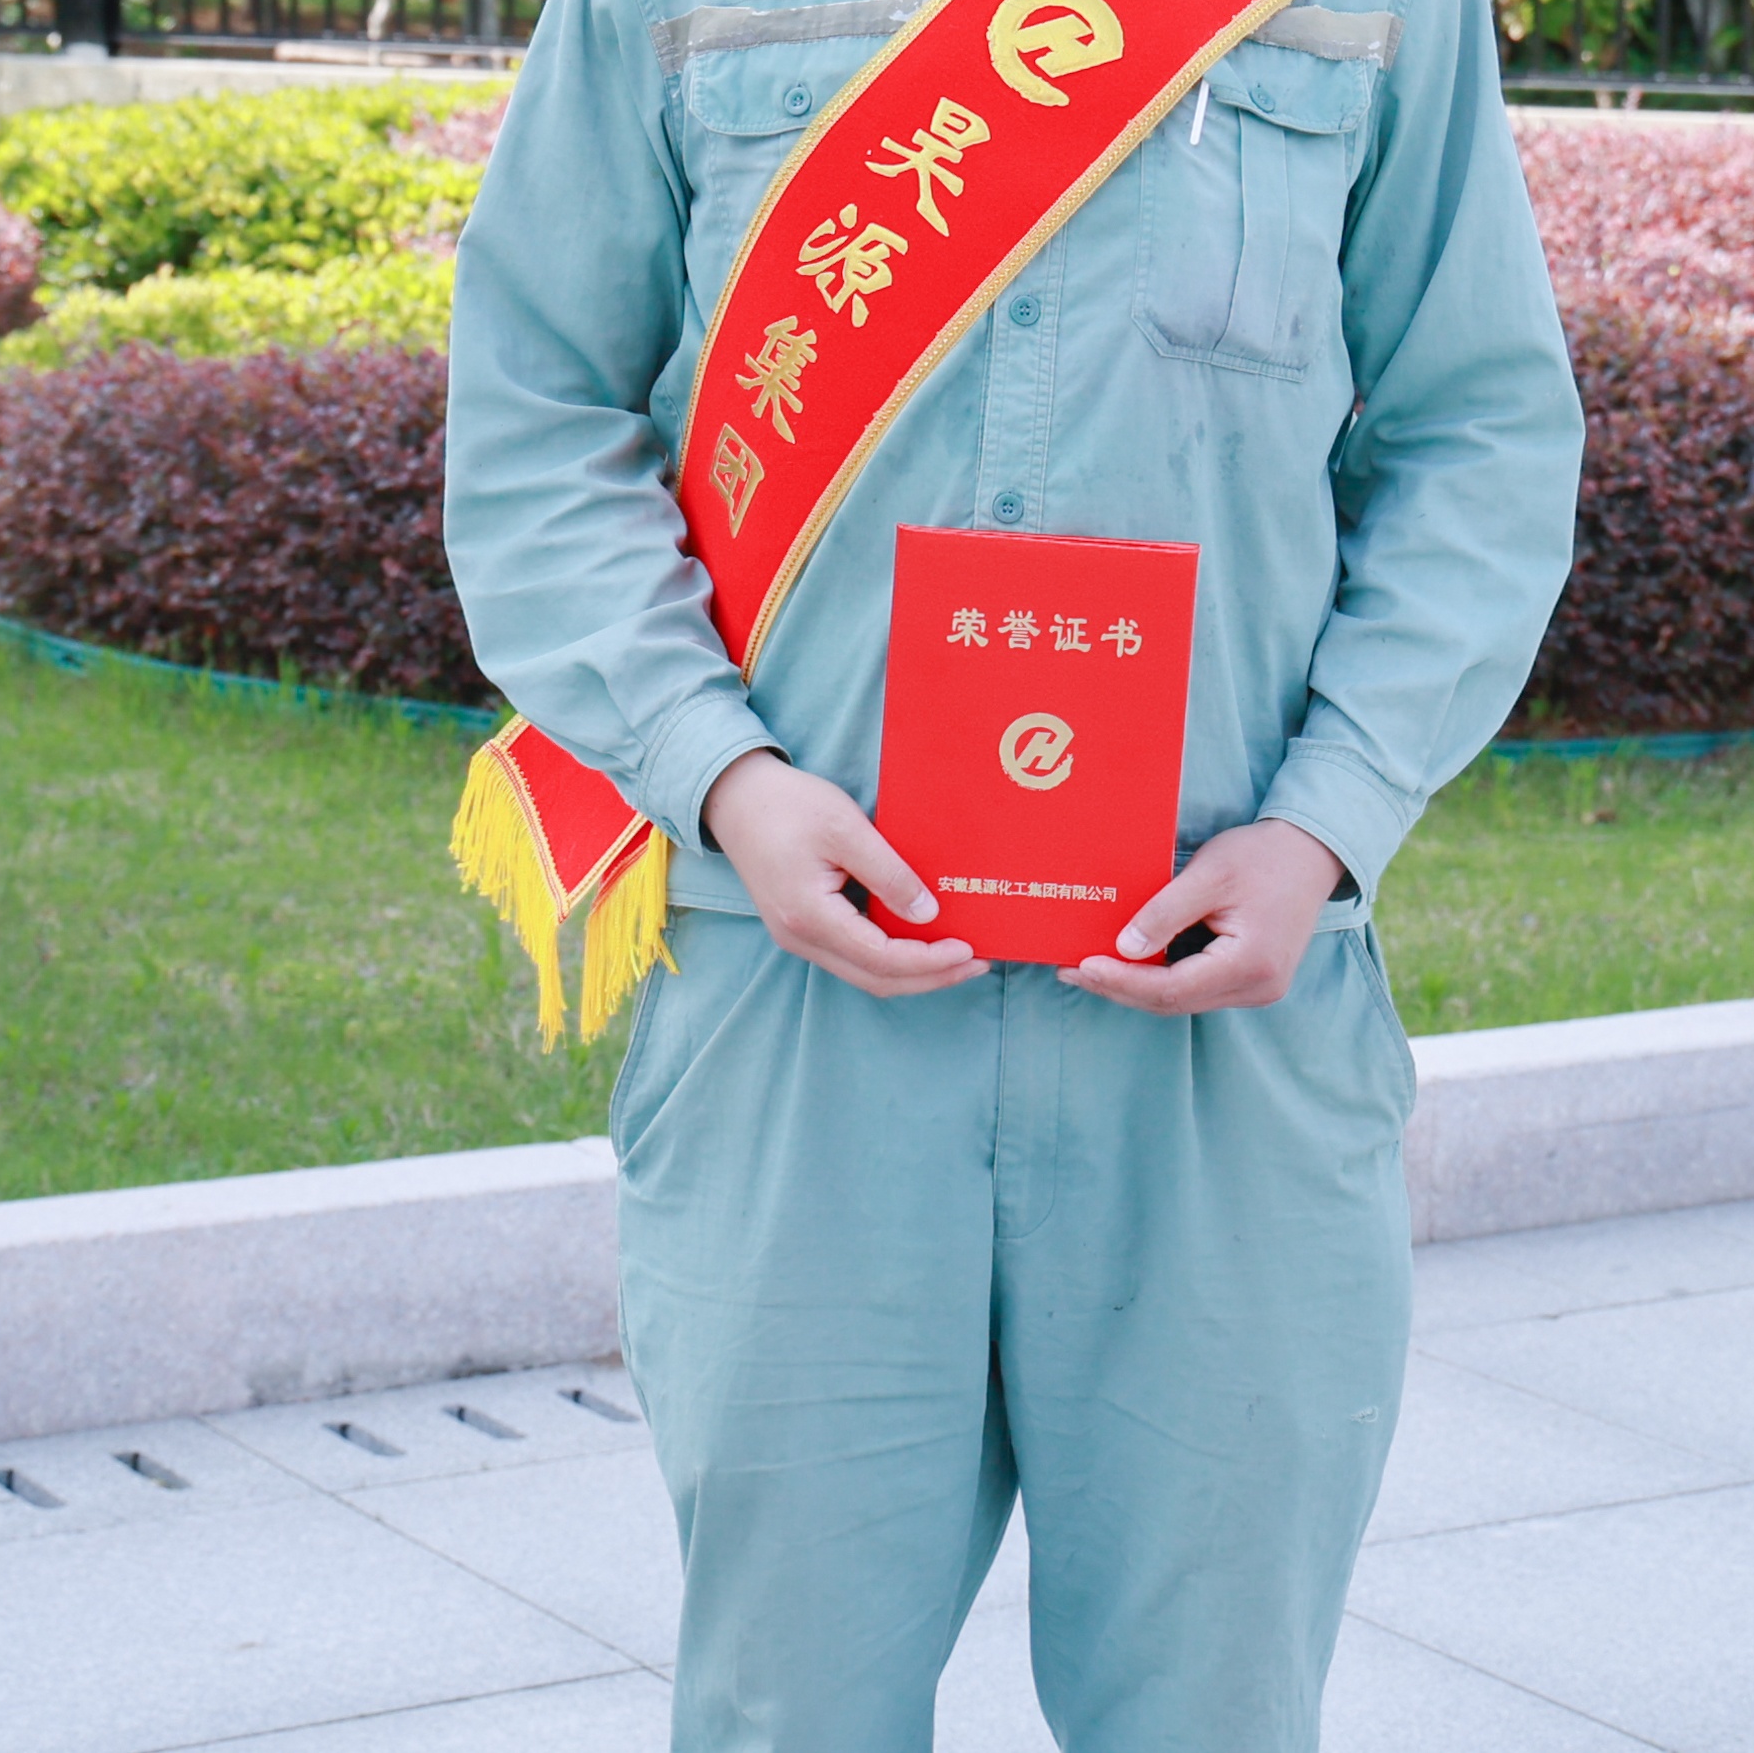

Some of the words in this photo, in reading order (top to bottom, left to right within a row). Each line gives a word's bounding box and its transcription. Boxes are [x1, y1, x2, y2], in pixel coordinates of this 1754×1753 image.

[708, 96, 992, 539] 昊源集团
[946, 607, 1143, 658] 荣誉证书
[937, 876, 1118, 902] 安徽昊源化工集团有限公司
